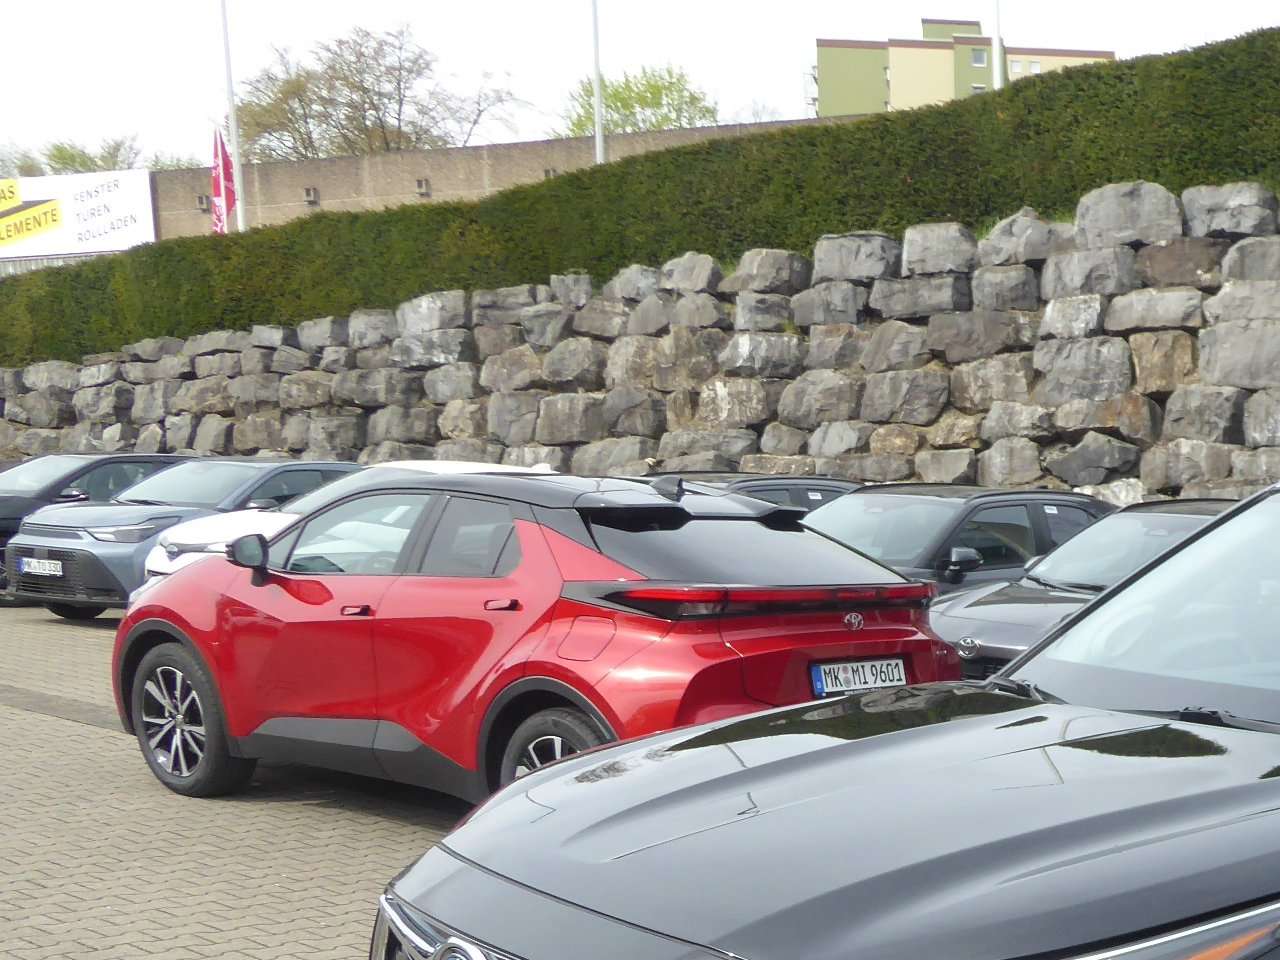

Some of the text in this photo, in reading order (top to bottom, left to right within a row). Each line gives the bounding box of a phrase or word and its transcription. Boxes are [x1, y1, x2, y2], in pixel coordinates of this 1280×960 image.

[823, 662, 903, 688] MK MI 9601
